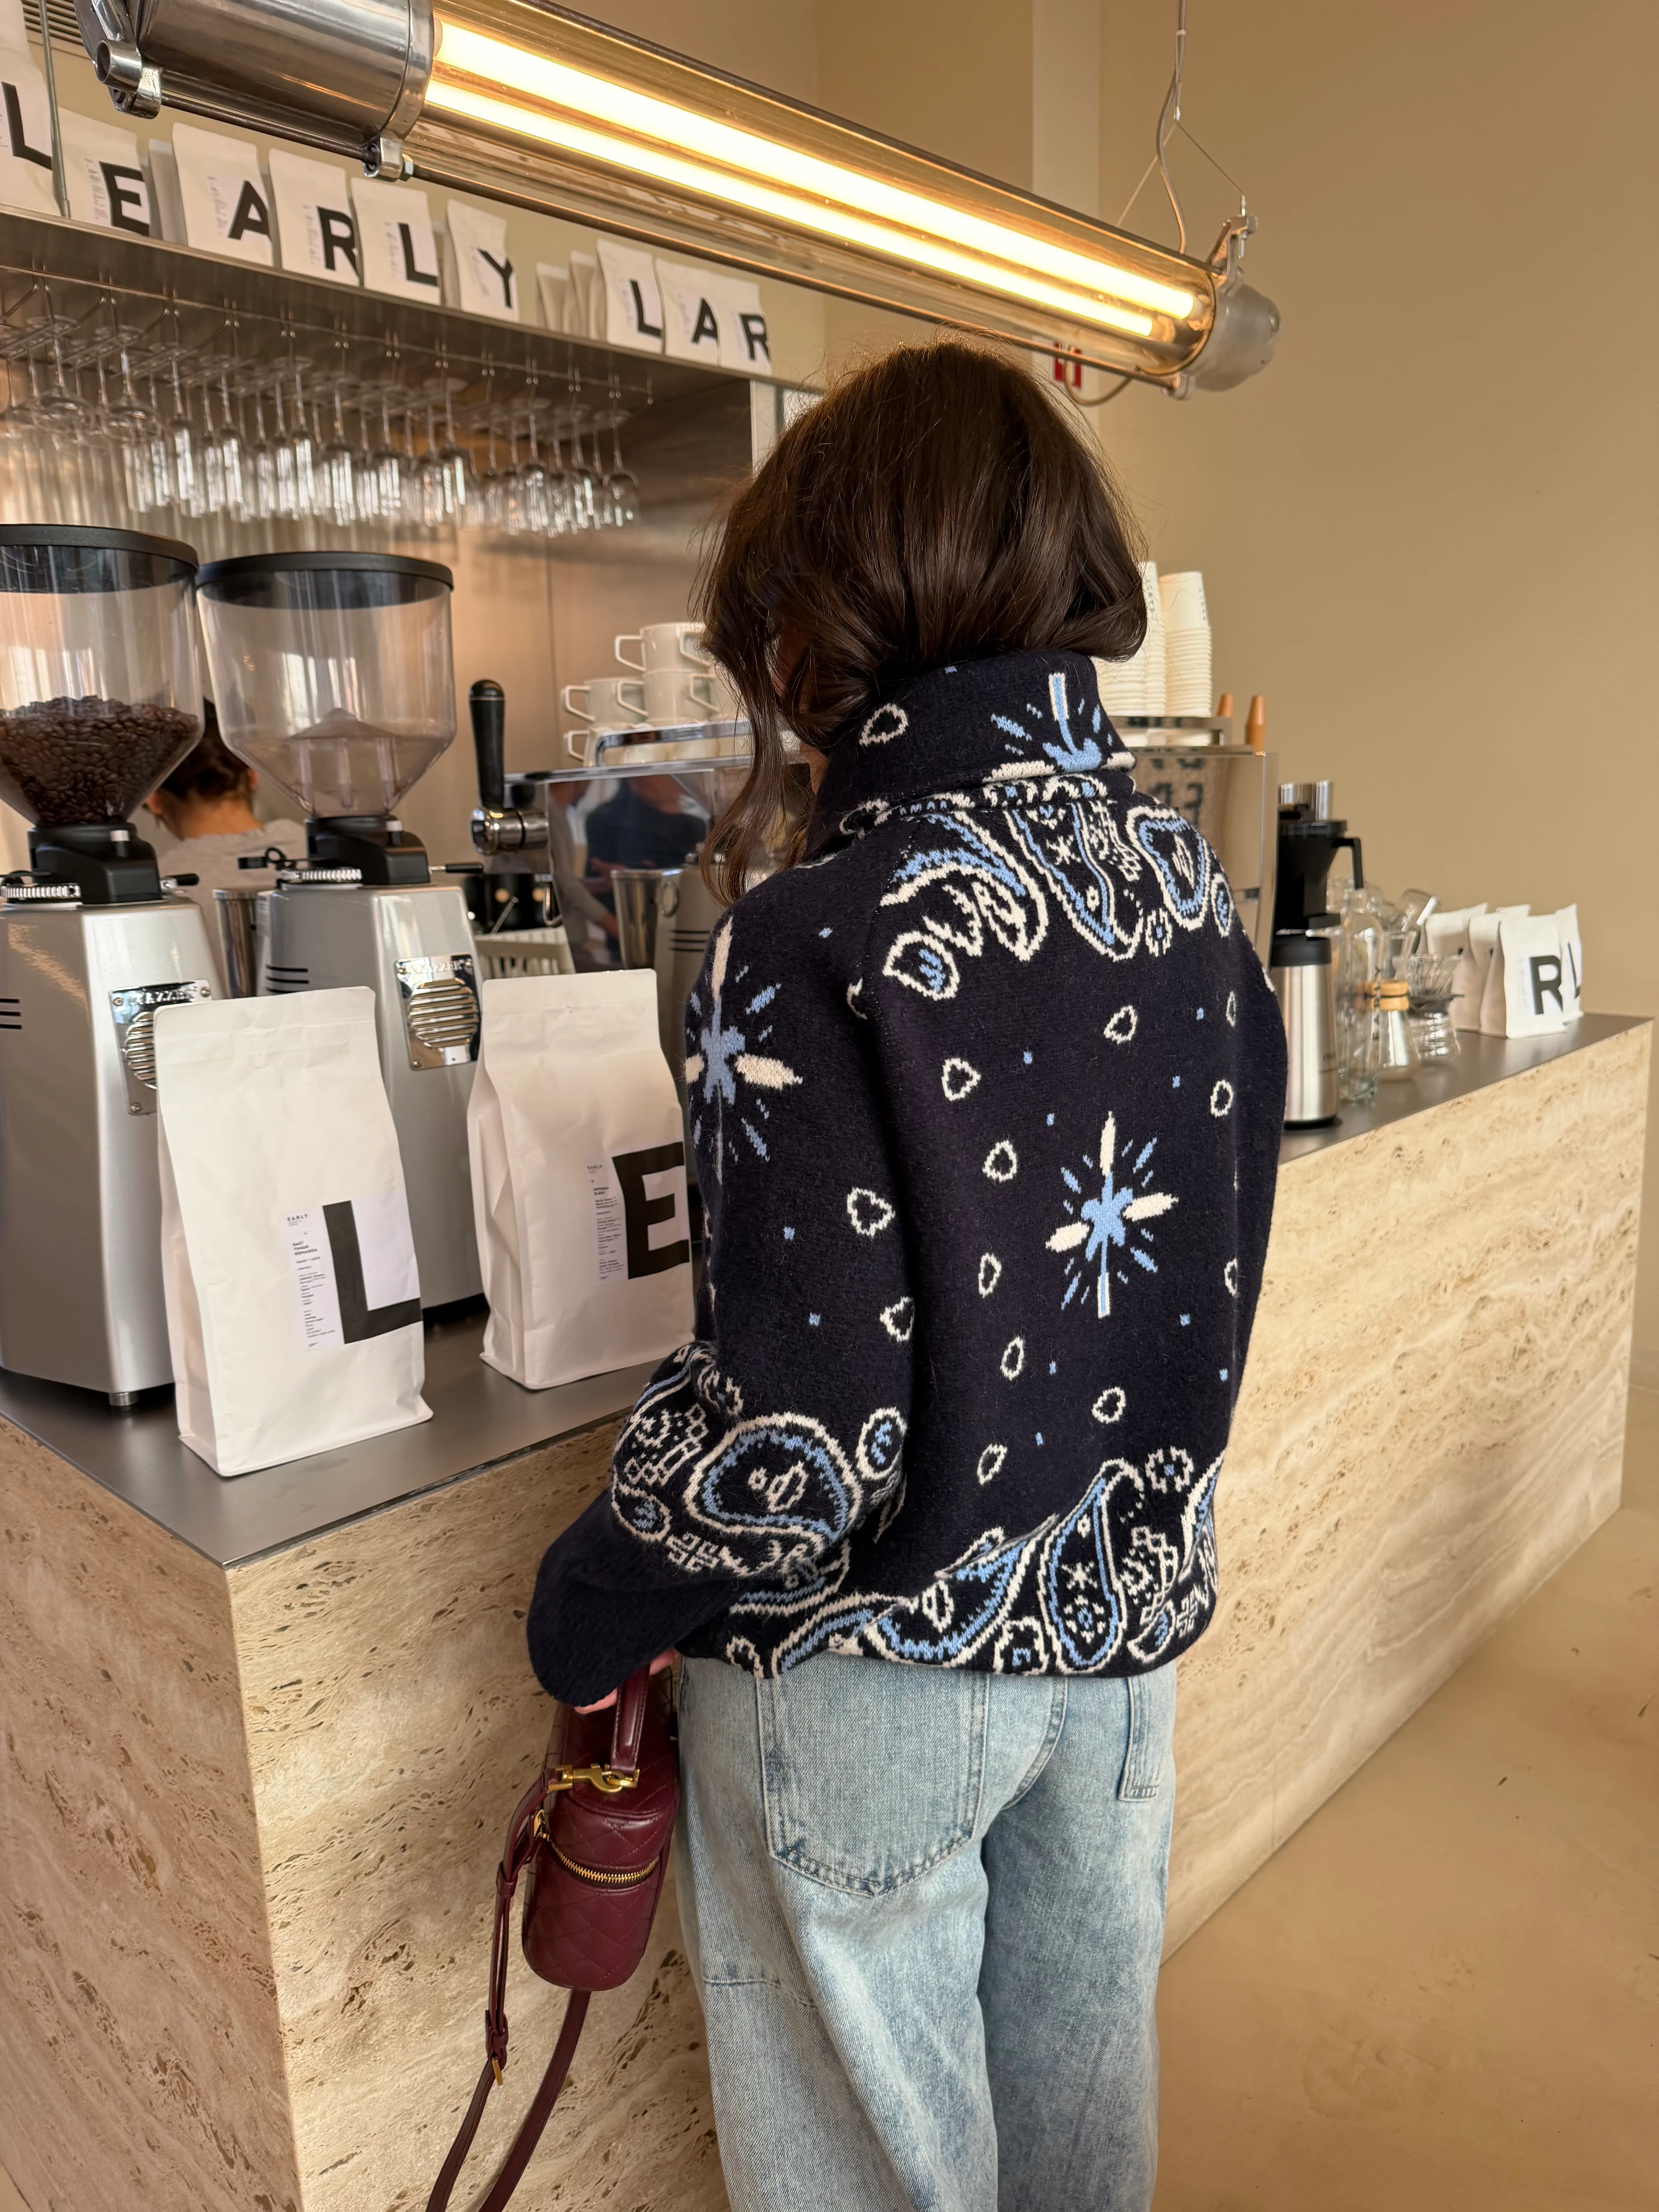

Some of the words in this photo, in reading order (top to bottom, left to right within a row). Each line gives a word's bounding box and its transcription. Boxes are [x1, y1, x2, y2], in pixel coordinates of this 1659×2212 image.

[1, 82, 52, 170] L
[98, 161, 149, 238] E
[227, 180, 272, 243] A
[316, 206, 359, 279] R
[397, 222, 439, 287] L
[476, 247, 513, 310] Y
[629, 280, 663, 340] L
[690, 297, 718, 344] A
[739, 313, 771, 361] R
[1529, 955, 1563, 1015] R
[612, 1142, 690, 1279] E
[322, 1200, 423, 1344] L
